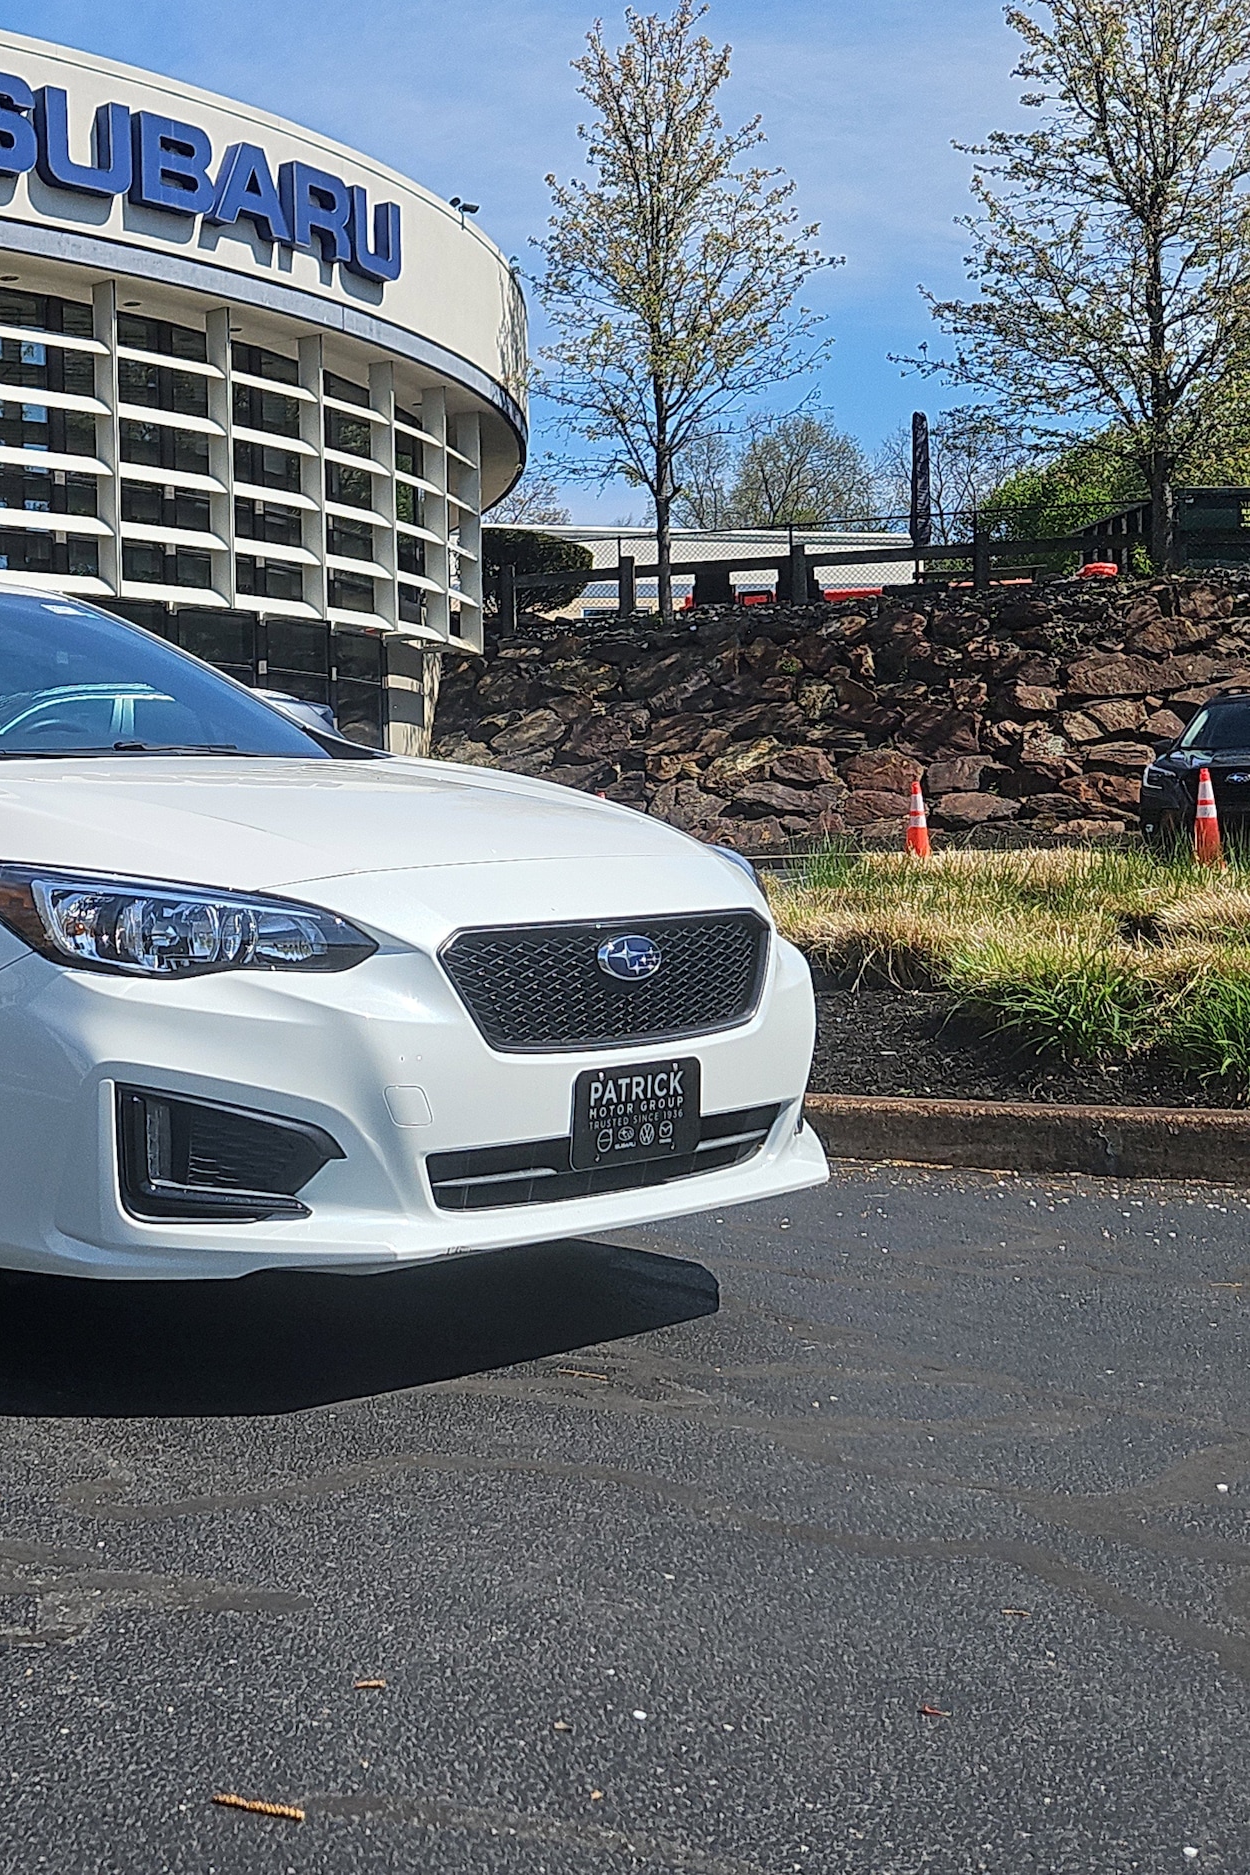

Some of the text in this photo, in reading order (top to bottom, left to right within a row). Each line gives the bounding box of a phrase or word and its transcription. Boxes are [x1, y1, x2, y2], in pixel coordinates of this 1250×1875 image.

[590, 1071, 684, 1107] PATRICK
[589, 1096, 684, 1120] MOTOR GROUP
[589, 1108, 684, 1131] TRUSTED SINCE 1936
